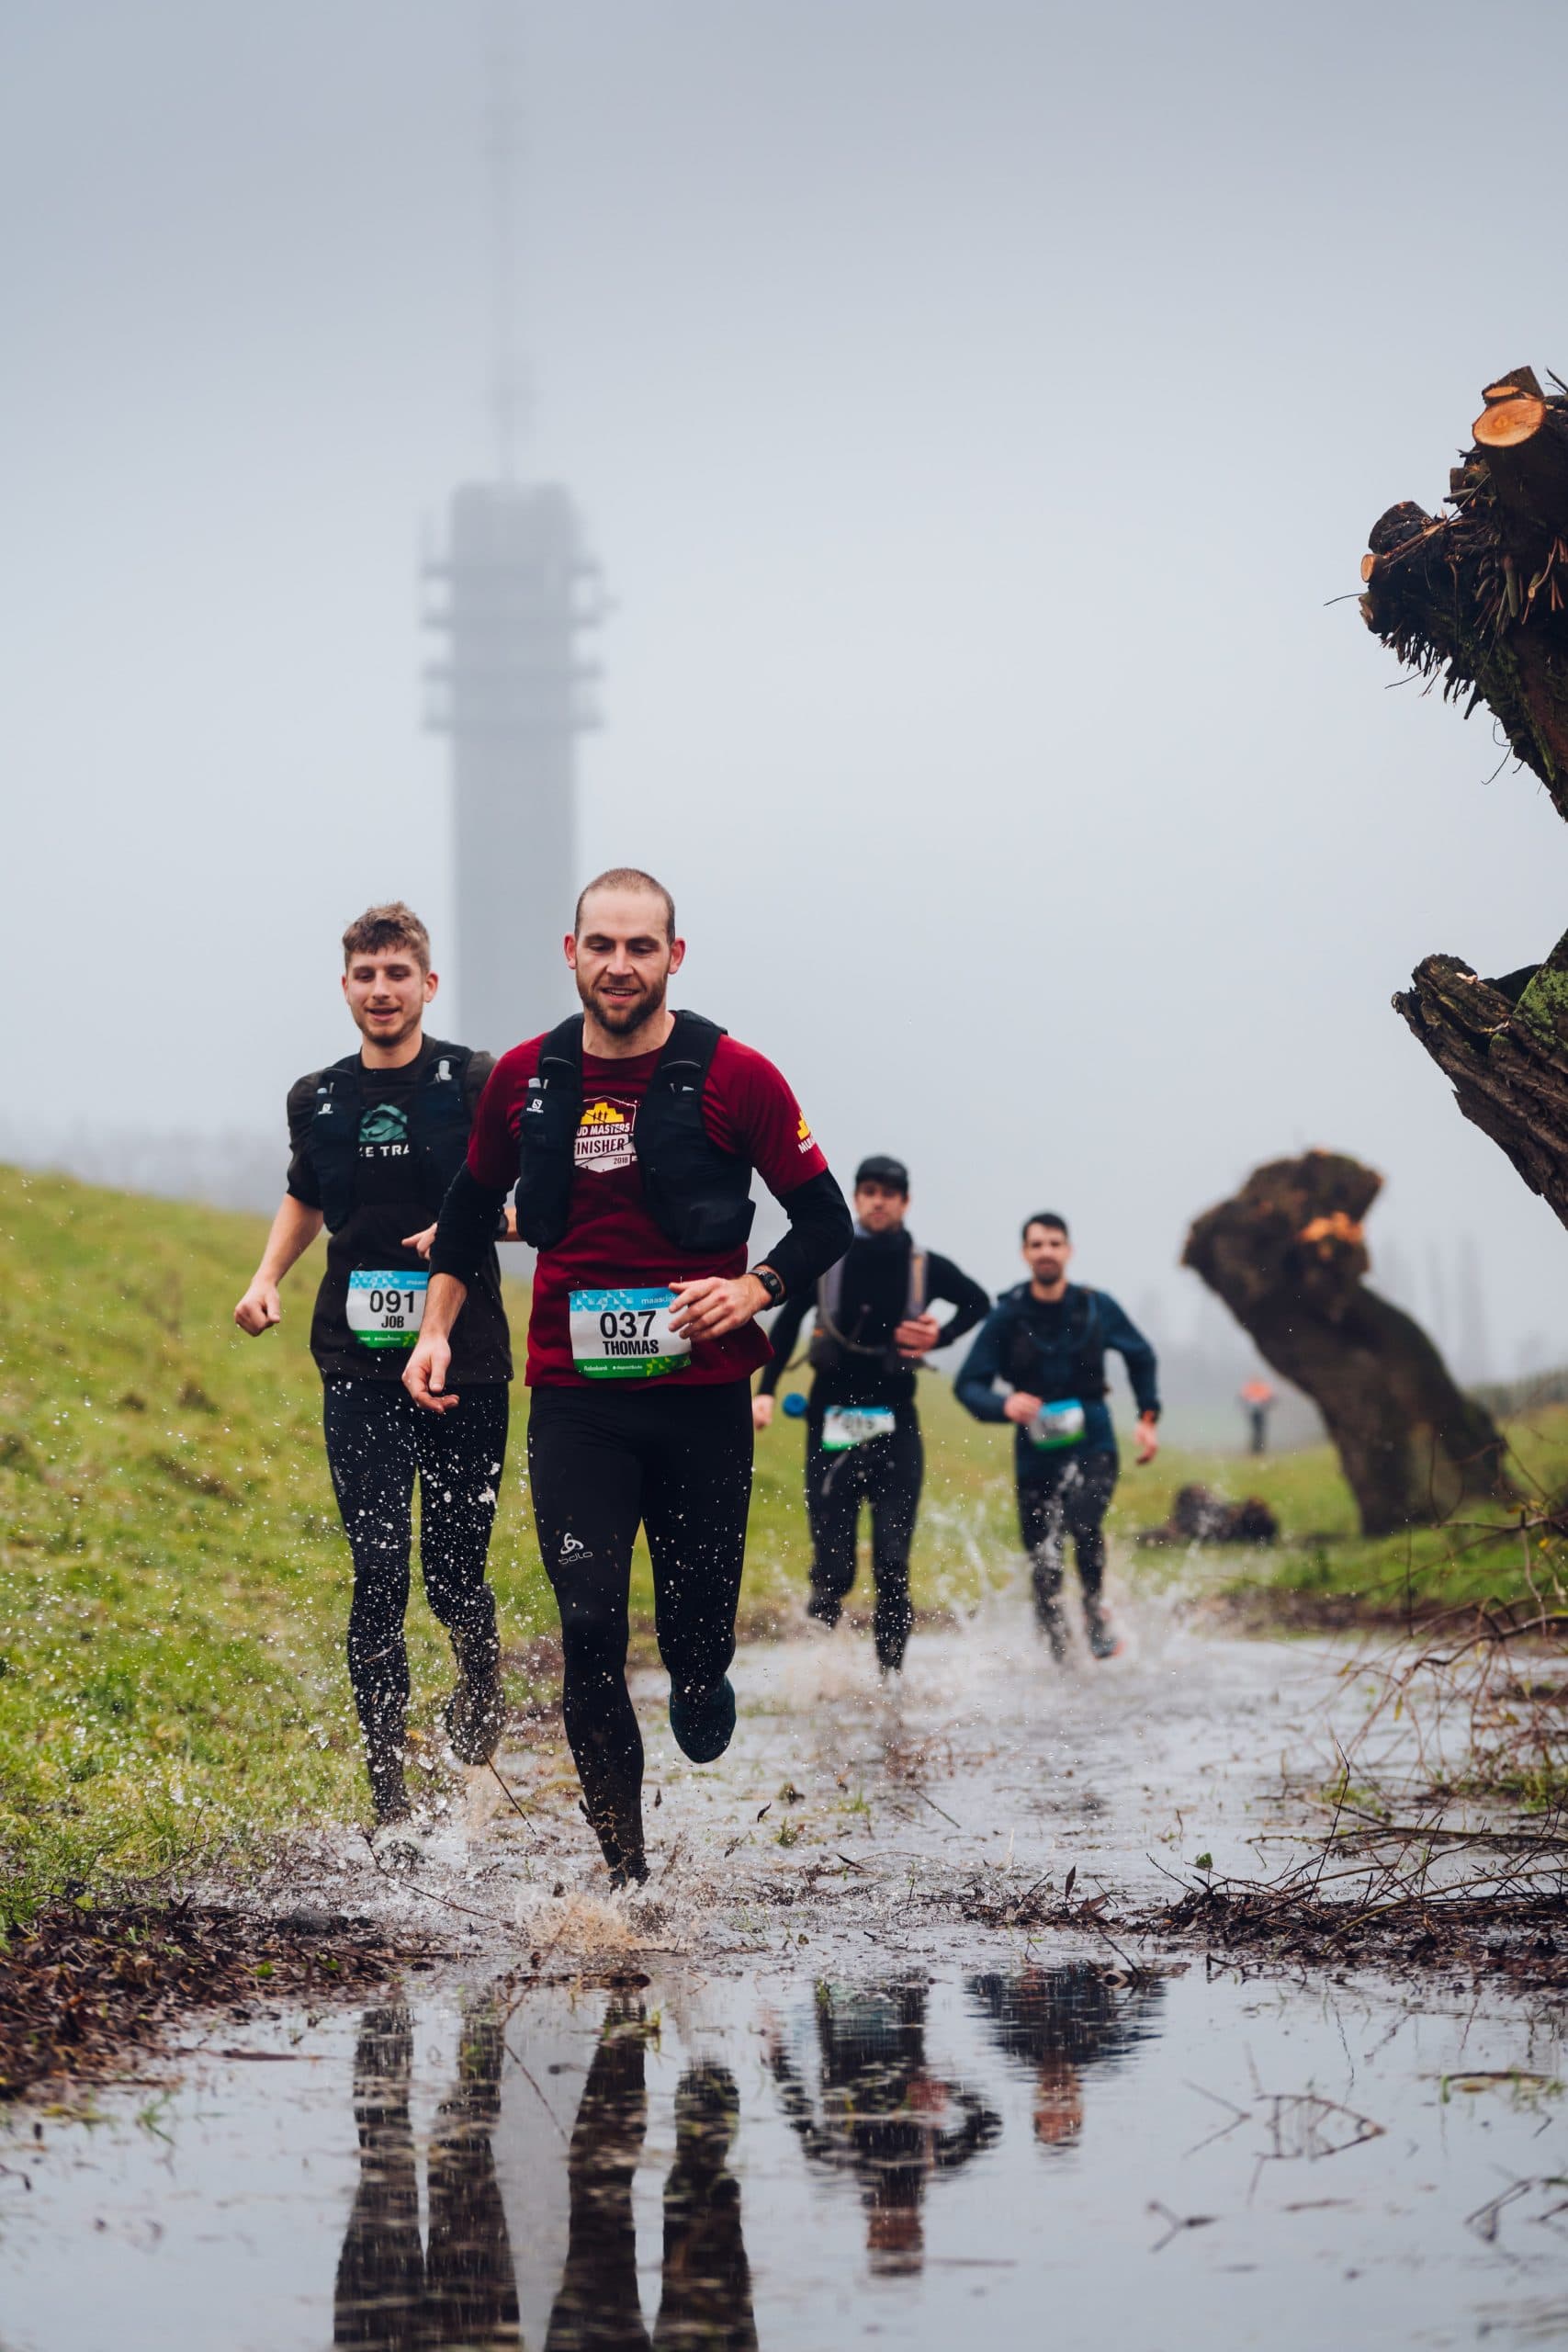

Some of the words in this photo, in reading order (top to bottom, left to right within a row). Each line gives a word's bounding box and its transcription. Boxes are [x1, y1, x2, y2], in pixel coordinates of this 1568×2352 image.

[577, 1126, 589, 1136] UD
[590, 1123, 630, 1136] MASTERS
[379, 1143, 410, 1157] TRA
[576, 1138, 626, 1156] INISHER
[369, 1289, 414, 1313] 091
[381, 1315, 404, 1329] JOB
[600, 1310, 657, 1339] 037
[603, 1340, 660, 1355] THOMAS
